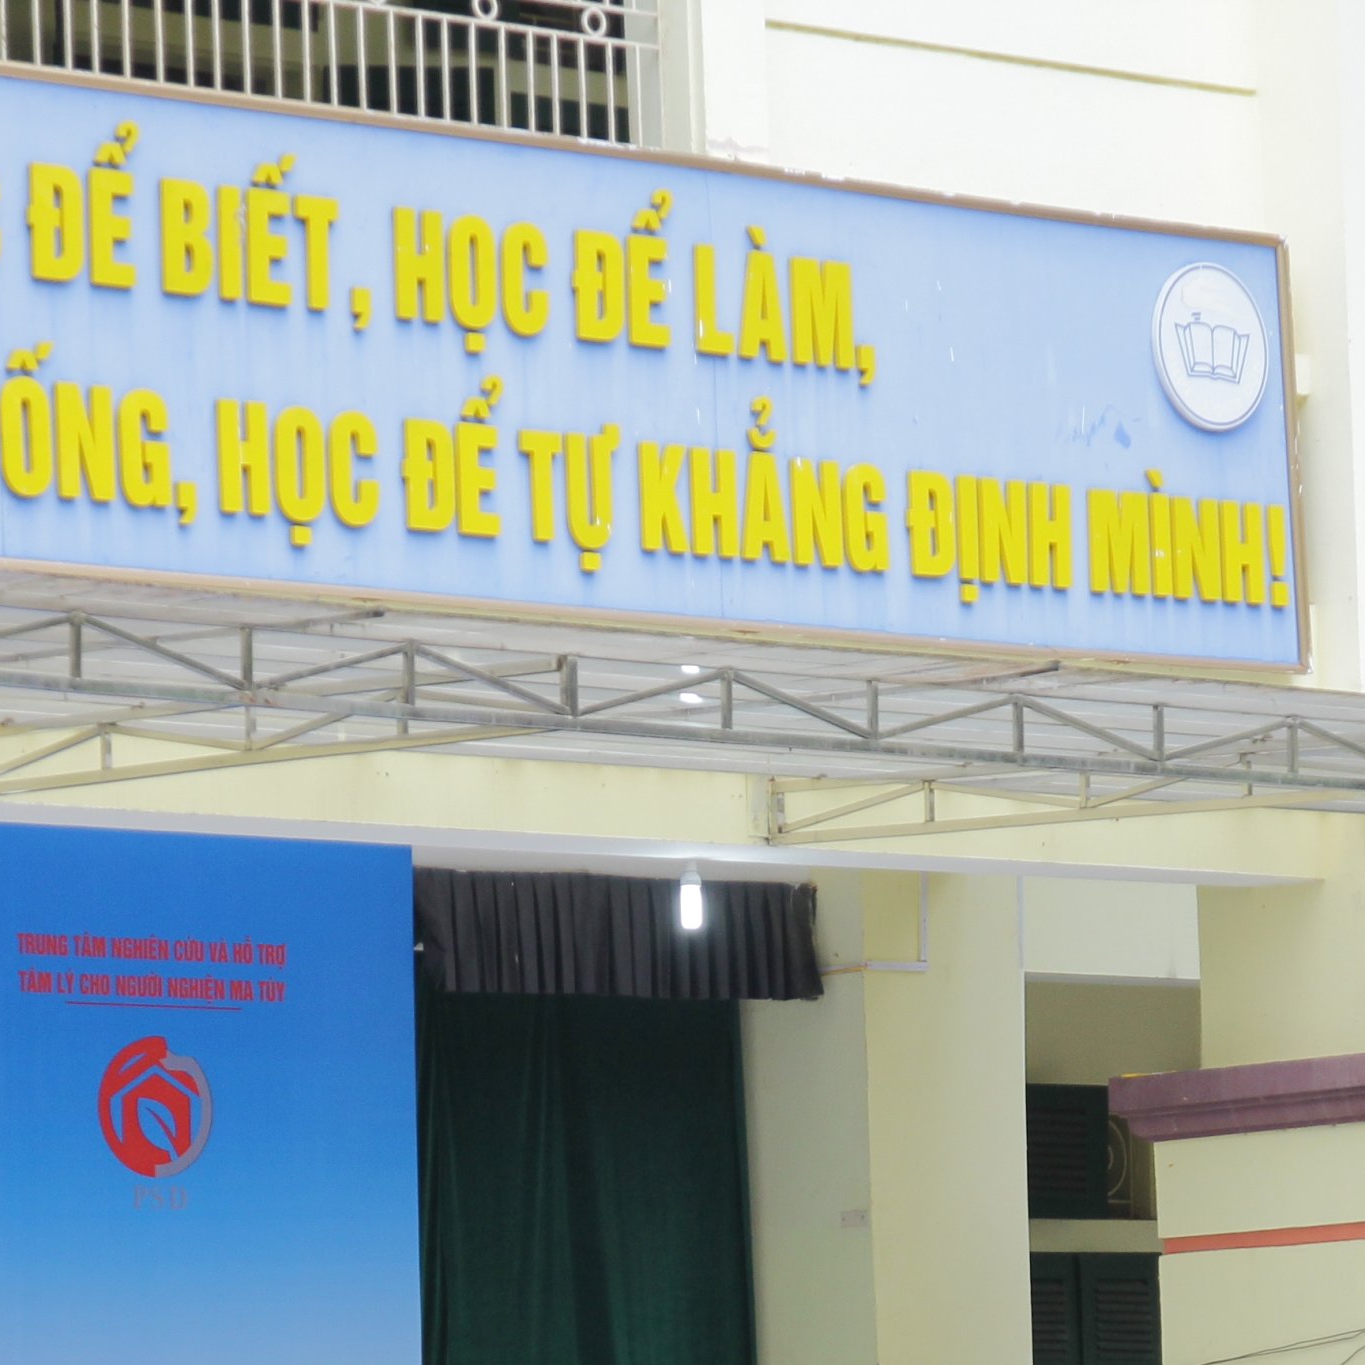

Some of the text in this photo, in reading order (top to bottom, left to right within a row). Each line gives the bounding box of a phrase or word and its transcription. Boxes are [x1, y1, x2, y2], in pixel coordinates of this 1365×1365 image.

[27, 120, 136, 290] ĐỂ
[393, 206, 549, 354] HỌC
[572, 190, 674, 349] ĐỂ
[693, 226, 877, 387] LÀM,
[217, 399, 379, 548] HỌC
[401, 375, 504, 539] ĐỂ
[517, 423, 621, 573] TỰ
[638, 396, 889, 573] KHẲNG
[905, 469, 1073, 605] ĐỊNH
[1087, 469, 1289, 608] MÌNH!
[17, 932, 69, 956] TRUNG
[73, 931, 107, 958] TÂM
[111, 934, 170, 961] NGHIÊN
[174, 936, 205, 963] CỨU
[209, 938, 229, 964] VÀ
[257, 942, 287, 970] TRỢ
[18, 967, 286, 1005] TÂM LÝ CHO NGƯỜI NGHIỆN MA TÚY
[132, 1184, 189, 1211] PSD
